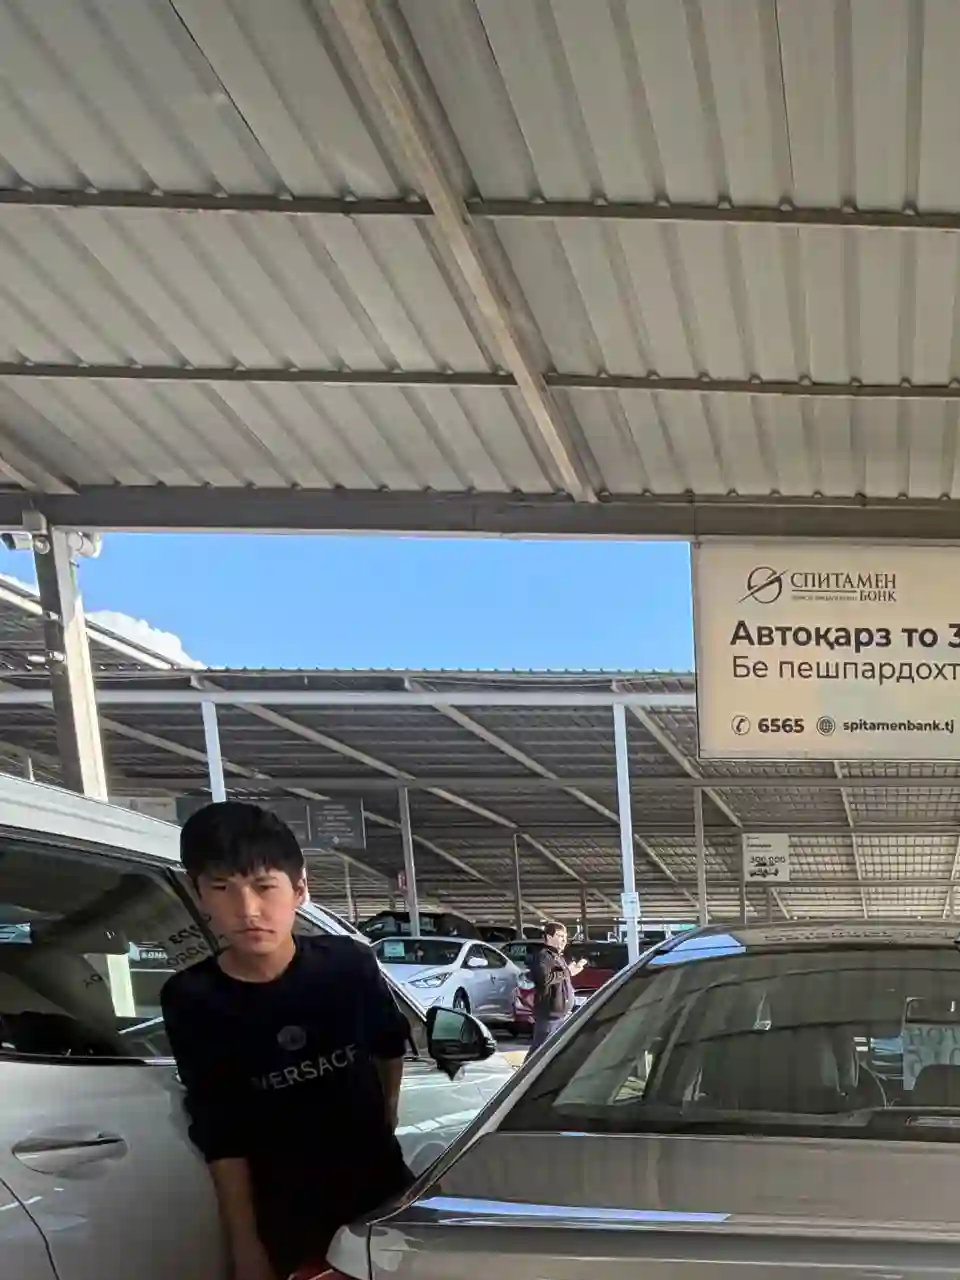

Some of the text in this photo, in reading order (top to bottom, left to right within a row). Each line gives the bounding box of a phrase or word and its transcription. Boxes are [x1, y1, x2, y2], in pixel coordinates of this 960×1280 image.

[790, 572, 897, 590] СПИТАМЕН
[859, 590, 897, 602] БОНК
[729, 620, 892, 653] Автоқарз
[902, 626, 938, 649] то
[733, 656, 769, 679] Бе
[757, 718, 954, 735] 6565 spitamenbank.tj
